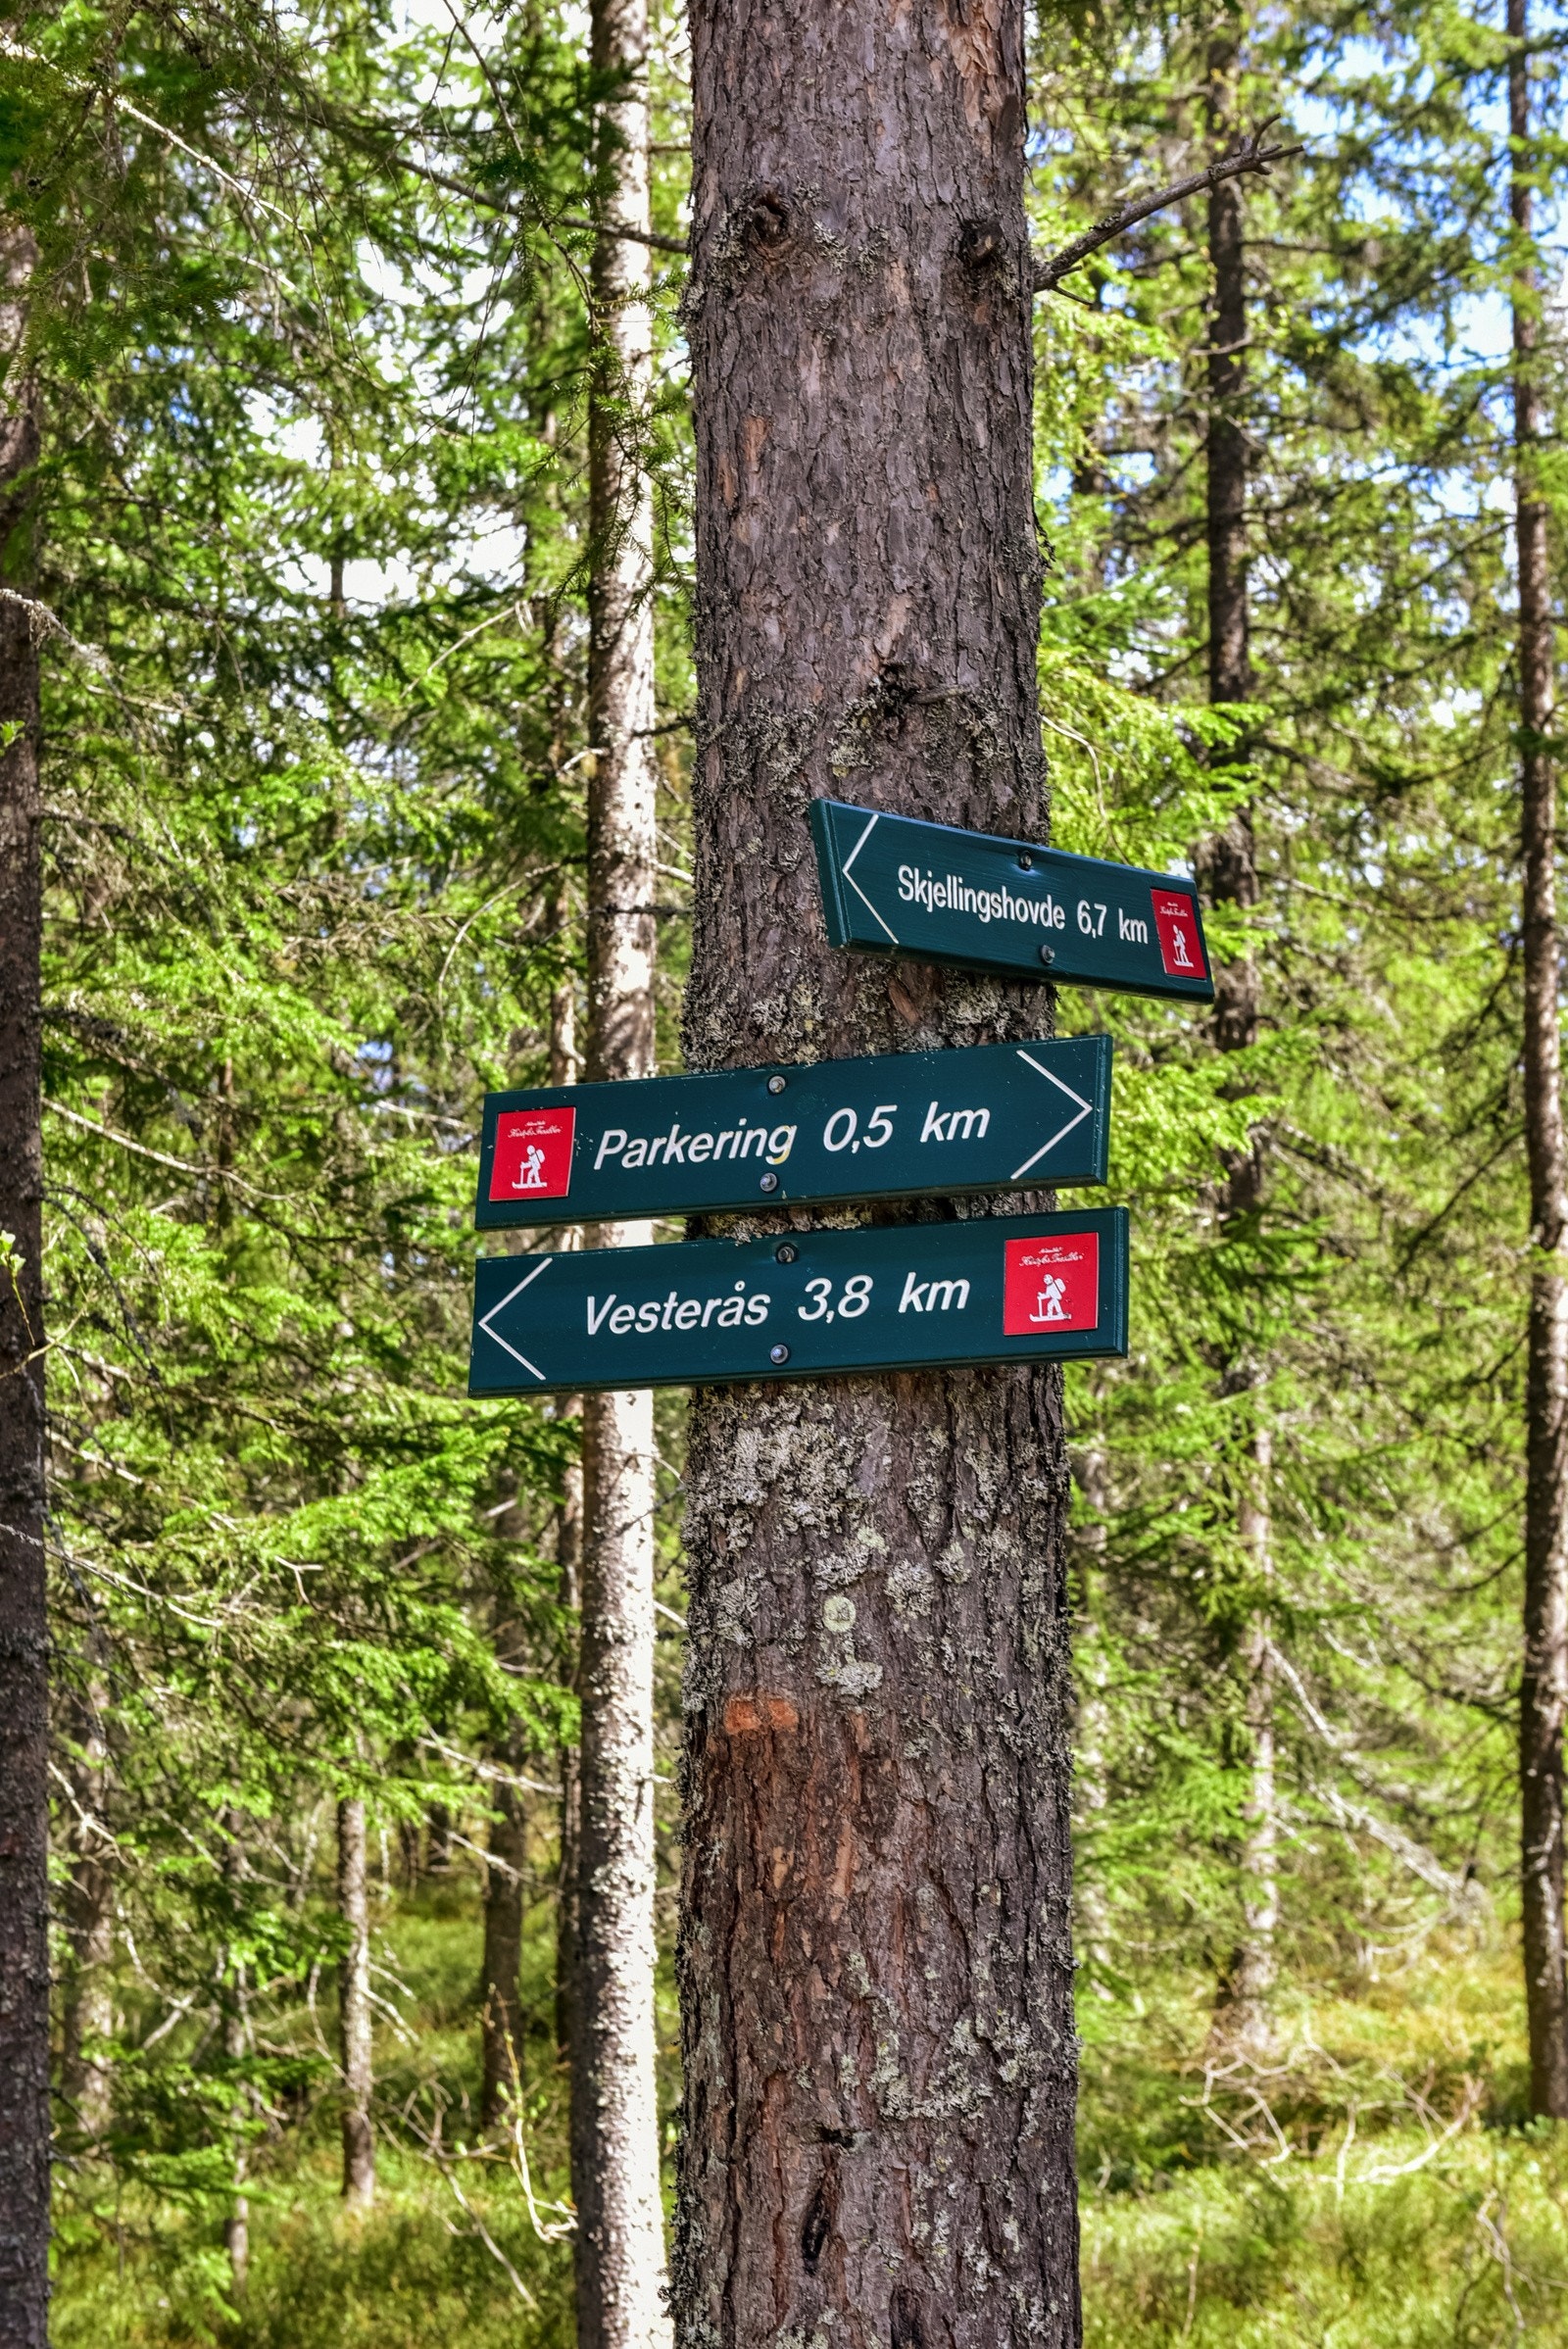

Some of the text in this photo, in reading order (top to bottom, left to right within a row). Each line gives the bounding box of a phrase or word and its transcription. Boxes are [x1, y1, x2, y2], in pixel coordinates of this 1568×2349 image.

[898, 864, 1149, 945] Skjellingshovde 6,7 km
[593, 1101, 991, 1170] Parkering 0,5 km
[587, 1271, 970, 1336] Vesterås 3,8 km
